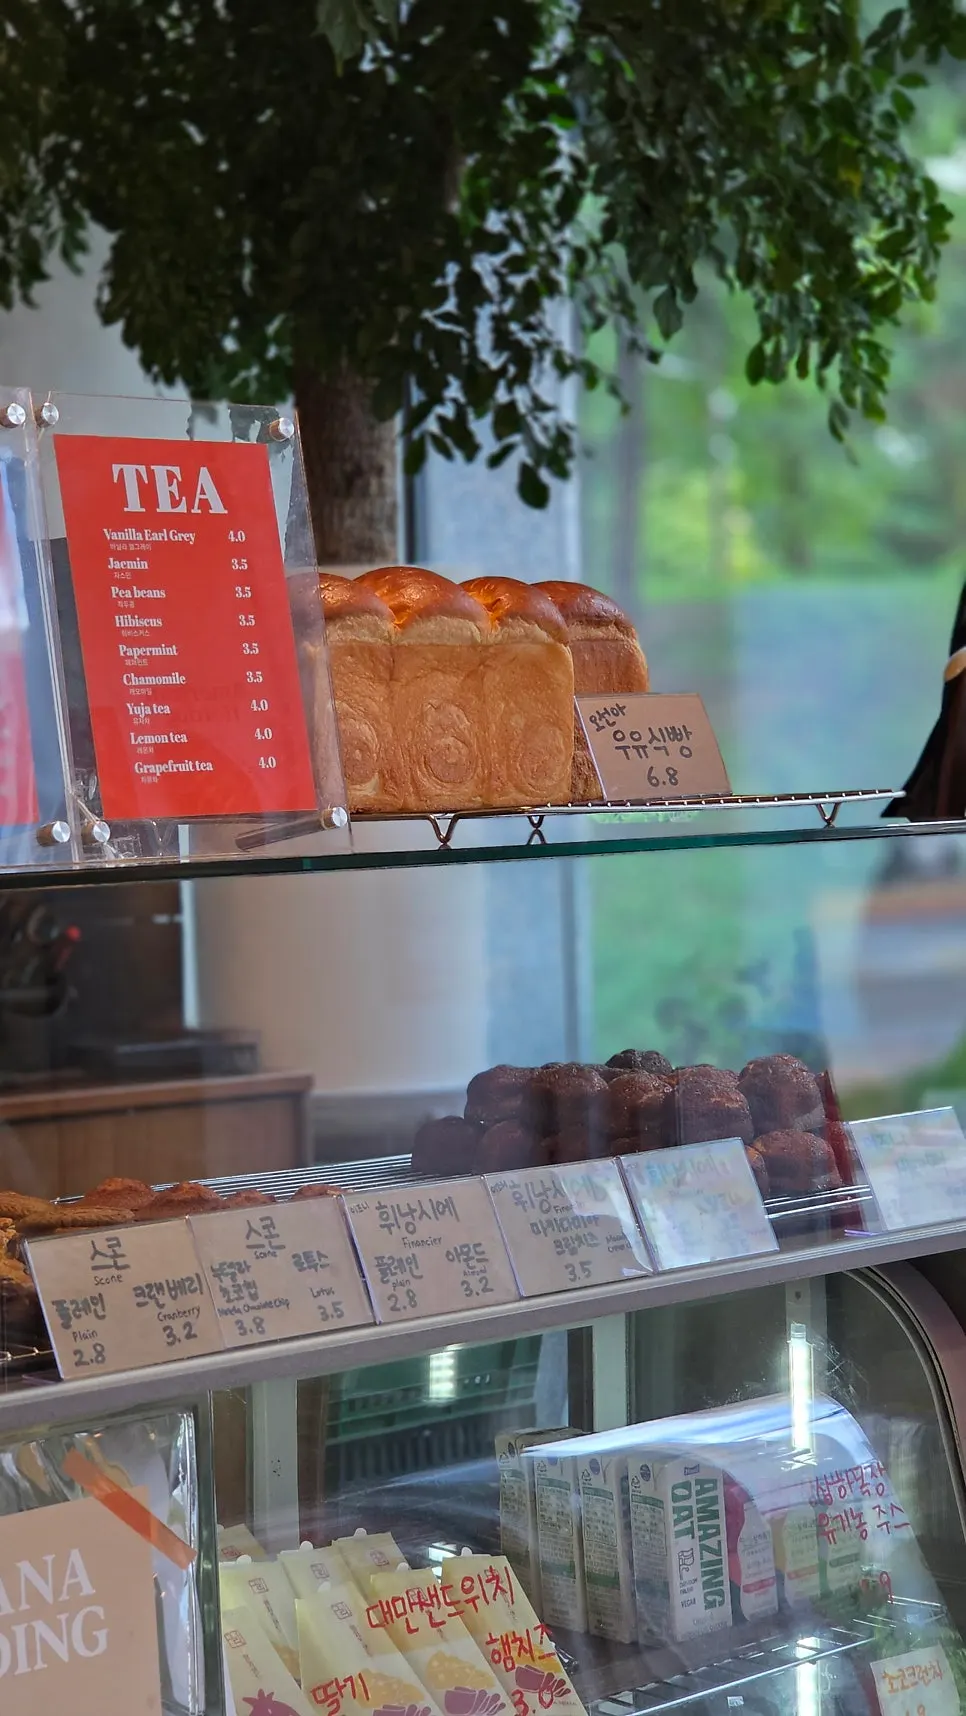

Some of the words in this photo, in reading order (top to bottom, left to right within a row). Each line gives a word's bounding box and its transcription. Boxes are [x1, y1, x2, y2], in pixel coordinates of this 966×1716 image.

[112, 464, 228, 514] TEA
[103, 528, 142, 541] Vanilla
[143, 529, 168, 542] Earl
[169, 530, 196, 545] Grey
[228, 531, 246, 542] 4.0
[232, 559, 248, 570] 3.5
[110, 586, 132, 598] Pea
[133, 586, 166, 598] beans
[235, 587, 252, 598] 3.5
[114, 615, 162, 627] Hibiscus
[239, 615, 256, 626] 3.5
[118, 643, 178, 658] Papermint
[242, 643, 260, 655] 3.5
[122, 672, 187, 686] Chamomile
[246, 671, 263, 683] 3.5
[126, 702, 152, 718] Yuja
[152, 703, 171, 714] tea
[250, 699, 269, 711] 4.0
[130, 732, 169, 745] Lemon
[170, 732, 188, 744] tea
[254, 728, 273, 740] 4.0
[612, 724, 693, 760] 우유식빵
[134, 760, 194, 776] Grapefruit
[195, 761, 213, 771] tea
[258, 757, 277, 768] 4.0
[647, 766, 679, 787] 6.8
[375, 1195, 460, 1235] 휘낭시에
[245, 1215, 286, 1250] 스콘
[401, 1236, 443, 1249] Financier
[90, 1236, 131, 1271] 스콘
[445, 1242, 490, 1270] 아몬드
[373, 1252, 424, 1285] 플레인
[564, 1260, 593, 1282] 3.5
[93, 1273, 124, 1286] Scone
[461, 1276, 495, 1298] 3.2
[132, 1272, 204, 1309] 크랜베리
[387, 1288, 418, 1312] 2.8
[51, 1293, 107, 1330] 플레인
[157, 1305, 201, 1323] Cranberry
[317, 1301, 345, 1322] 3.5
[72, 1330, 98, 1343] Plain
[162, 1321, 198, 1346] 3.2
[234, 1316, 266, 1336] 3.8
[72, 1343, 106, 1367] 2.8
[815, 1461, 888, 1506] 상하목장
[671, 1479, 696, 1541] OAT
[817, 1507, 868, 1545] 유기농
[872, 1503, 911, 1534] 주스
[694, 1478, 726, 1611] AMAZING
[366, 1565, 515, 1635] 대만샌드위치
[485, 1622, 557, 1672] 햄치즈
[310, 1672, 370, 1716] 딸기
